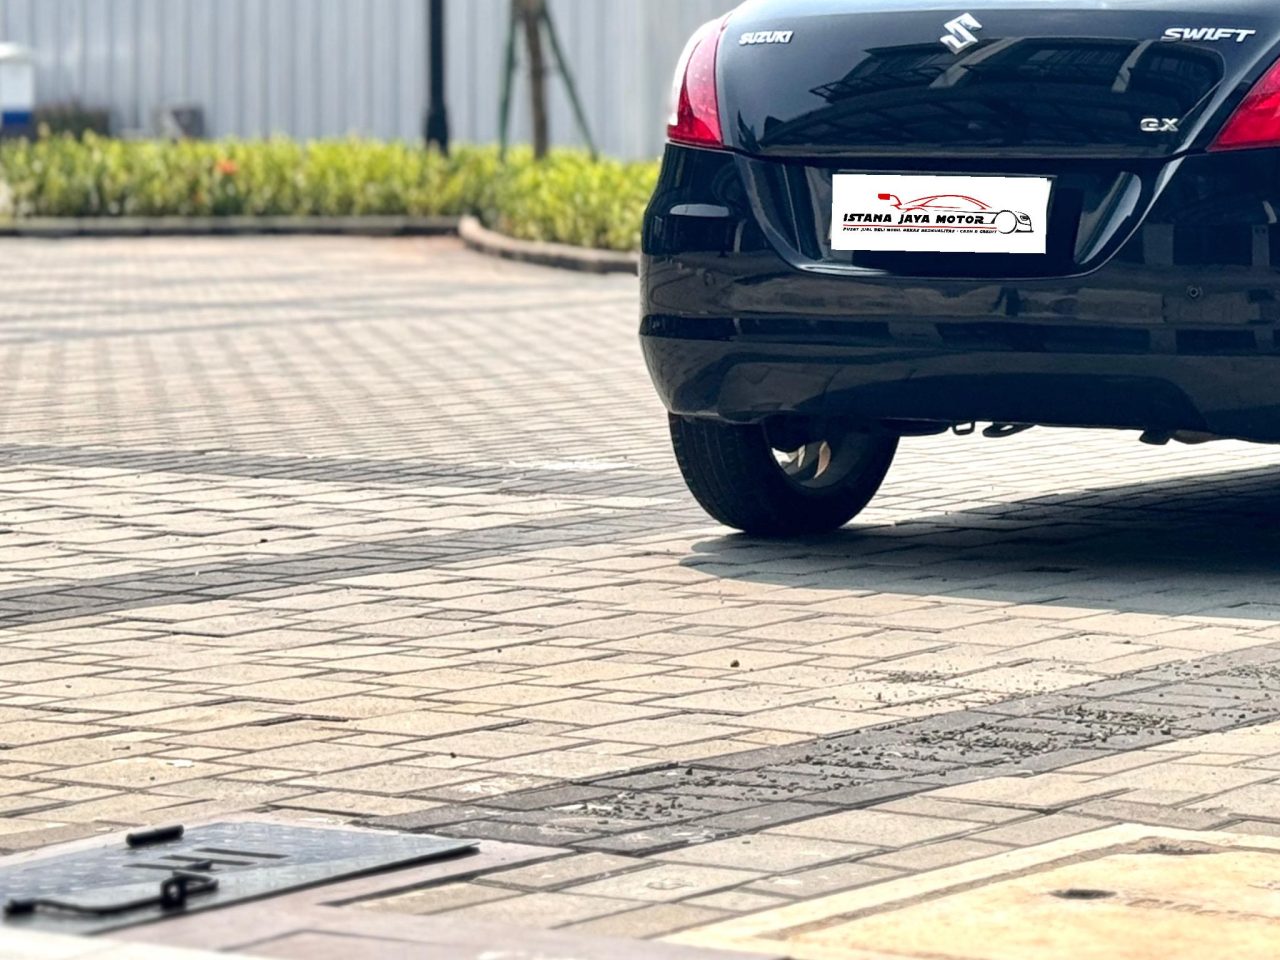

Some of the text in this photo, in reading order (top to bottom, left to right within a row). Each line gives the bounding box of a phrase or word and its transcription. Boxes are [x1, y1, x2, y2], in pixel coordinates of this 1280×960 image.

[738, 30, 794, 45] SUZUKI
[1159, 27, 1257, 43] SWIFT
[1140, 117, 1179, 132] GX
